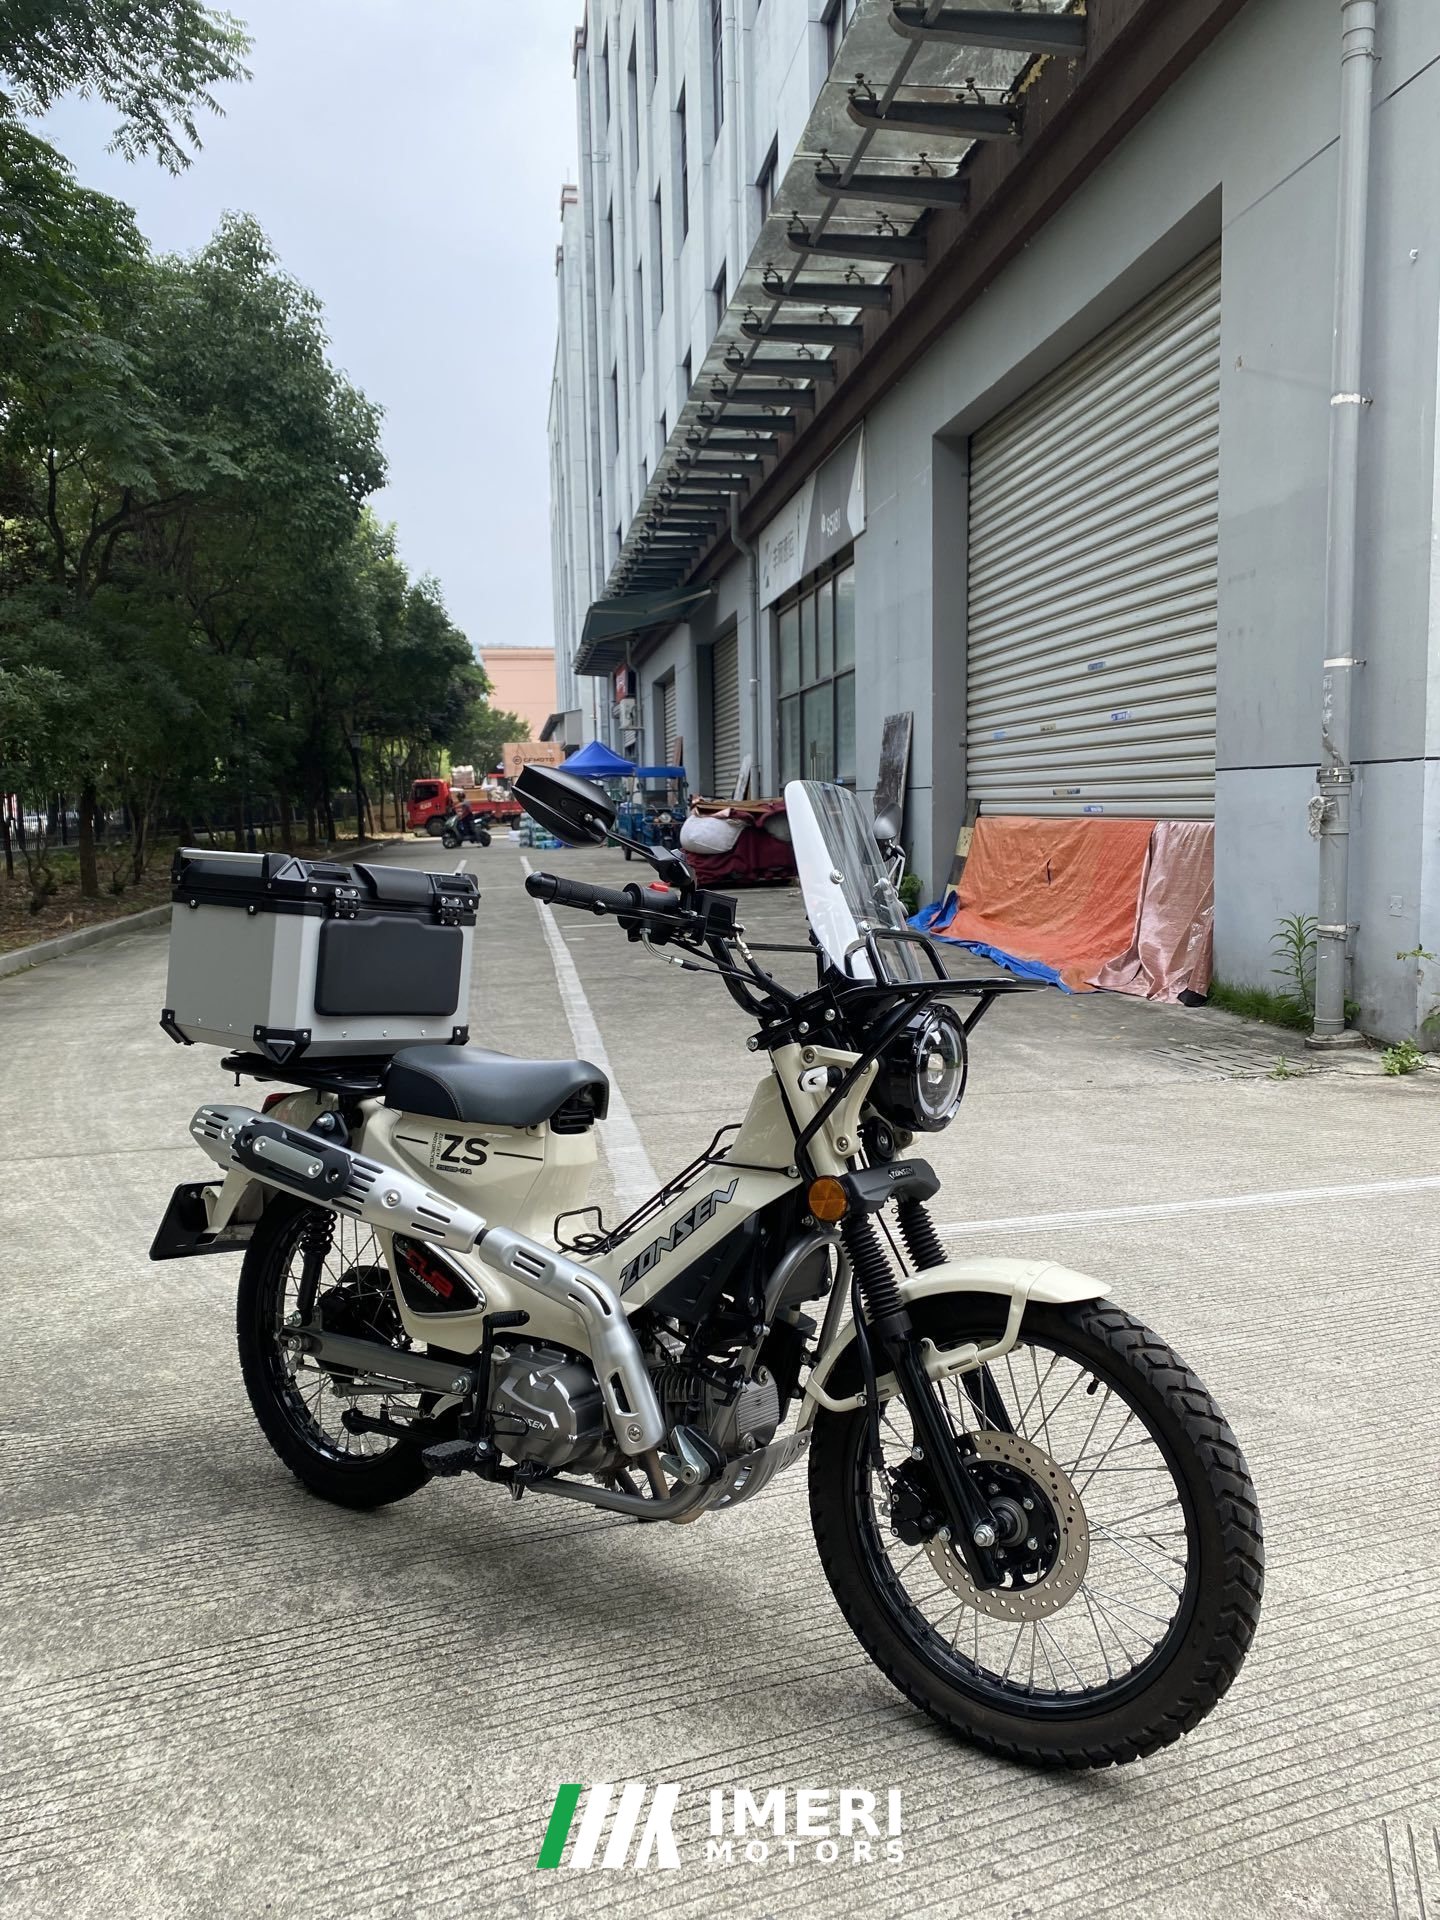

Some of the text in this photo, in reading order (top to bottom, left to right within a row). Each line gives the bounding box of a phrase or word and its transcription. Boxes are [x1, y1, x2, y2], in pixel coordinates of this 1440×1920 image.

[430, 1132, 439, 1168] MOTORCYCLE
[436, 1132, 444, 1157] ZONSEN
[440, 1134, 490, 1166] ZS
[619, 1177, 739, 1297] ZONSEN
[409, 1267, 440, 1297] CLAMBER
